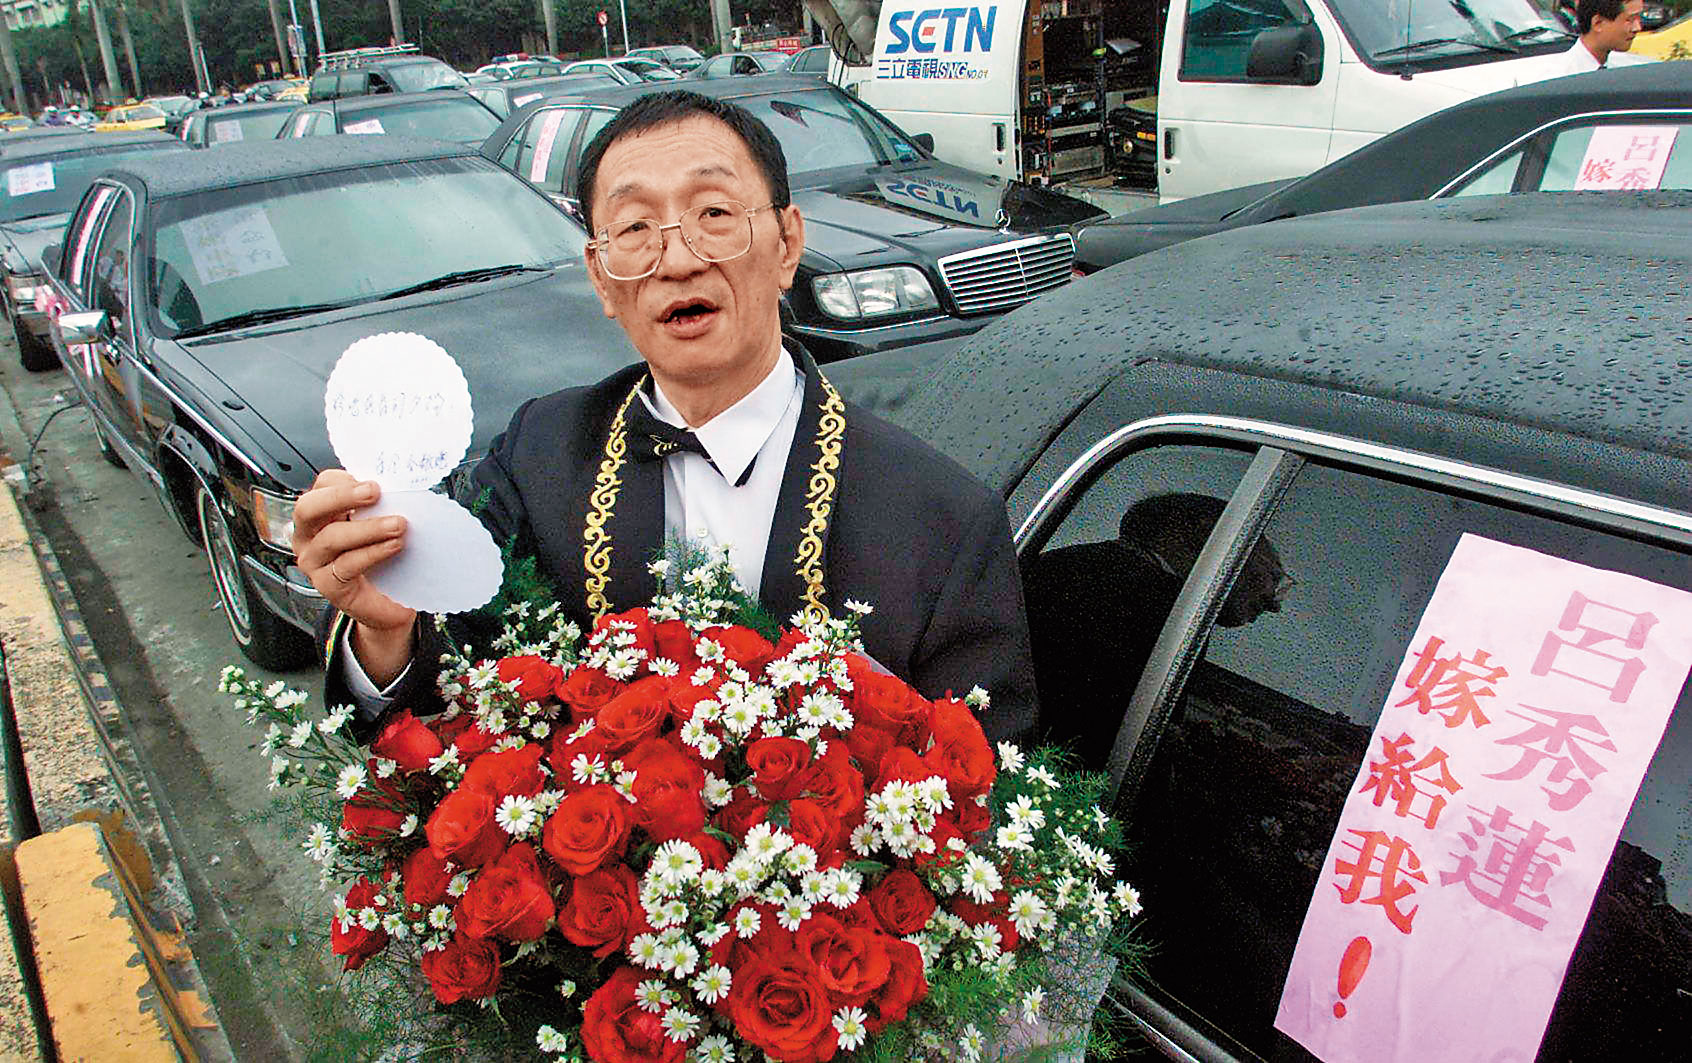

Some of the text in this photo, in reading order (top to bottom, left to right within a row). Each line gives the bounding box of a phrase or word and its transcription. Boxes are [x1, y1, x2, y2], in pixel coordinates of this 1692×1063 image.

[885, 6, 997, 54] SETN
[1583, 158, 1616, 183] 嫁
[1439, 590, 1659, 932] 呂秀蓮
